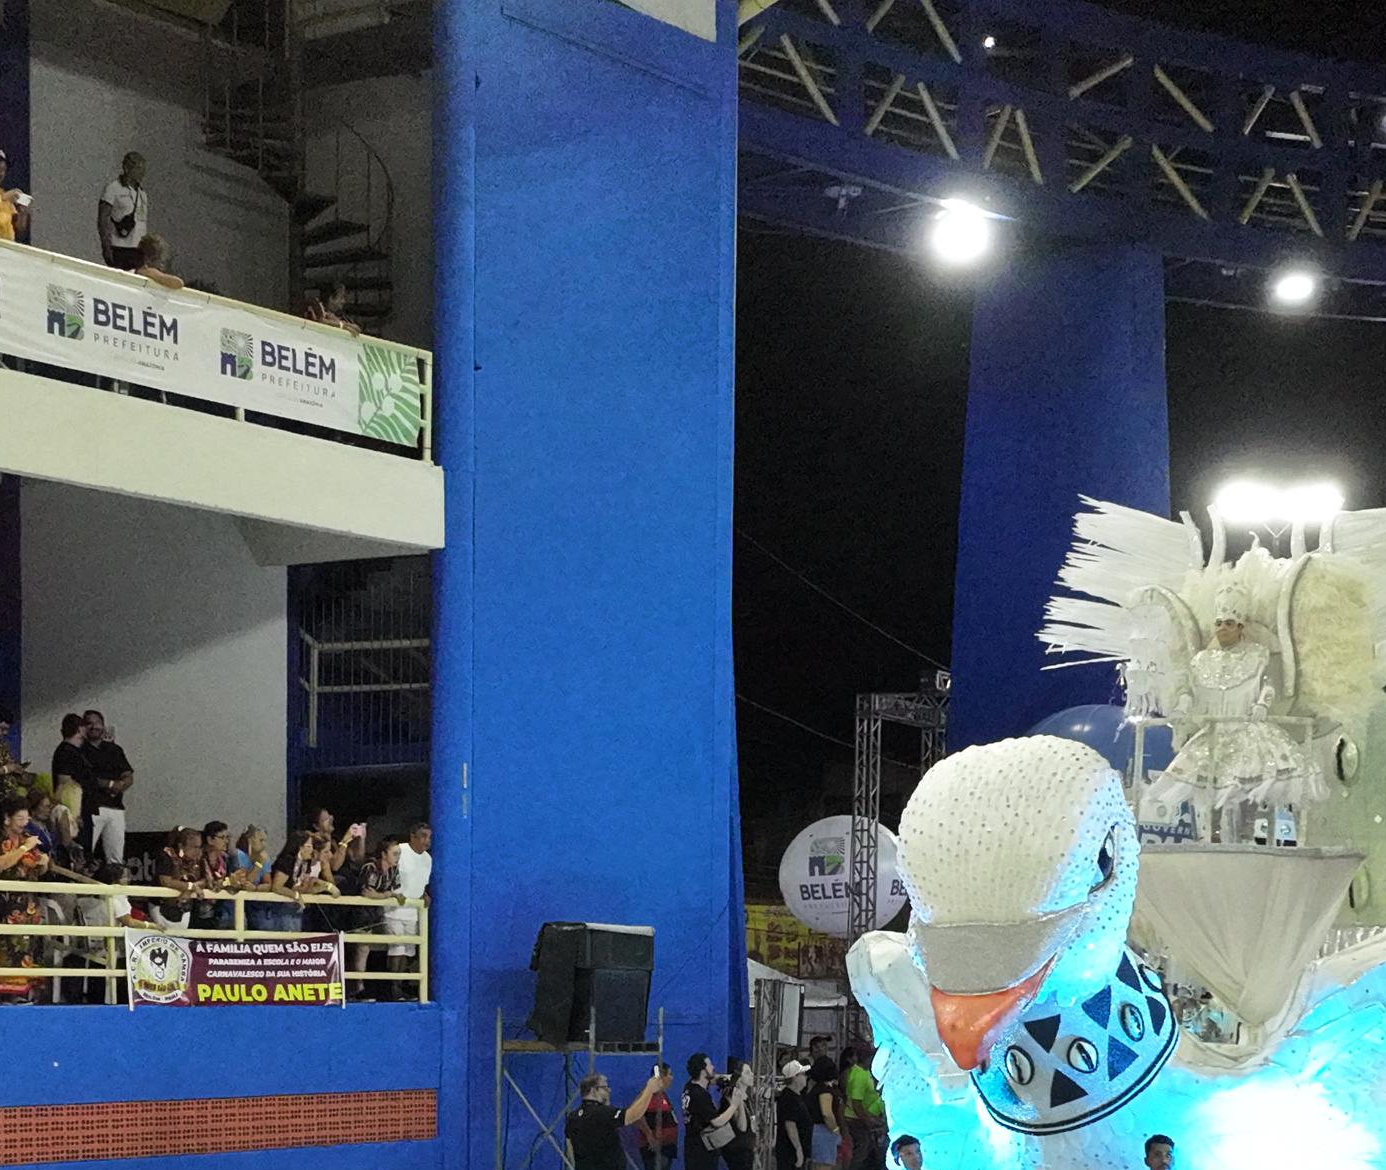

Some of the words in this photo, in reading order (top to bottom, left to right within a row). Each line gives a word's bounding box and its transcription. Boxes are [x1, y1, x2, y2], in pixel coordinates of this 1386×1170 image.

[93, 298, 178, 345] BELÉM
[93, 333, 179, 361] PREFEITURA
[261, 340, 336, 383] BELÉM
[261, 373, 336, 399] PREFEITURA
[196, 943, 205, 953] A
[253, 943, 285, 955] QUEM
[285, 941, 309, 953] SÃO
[310, 942, 333, 953] ELES
[206, 970, 264, 978] CARNAVALESCO
[265, 970, 276, 978] DA
[276, 969, 291, 977] SUA
[197, 983, 268, 1002] PAULO
[274, 982, 342, 1001] ANETE
